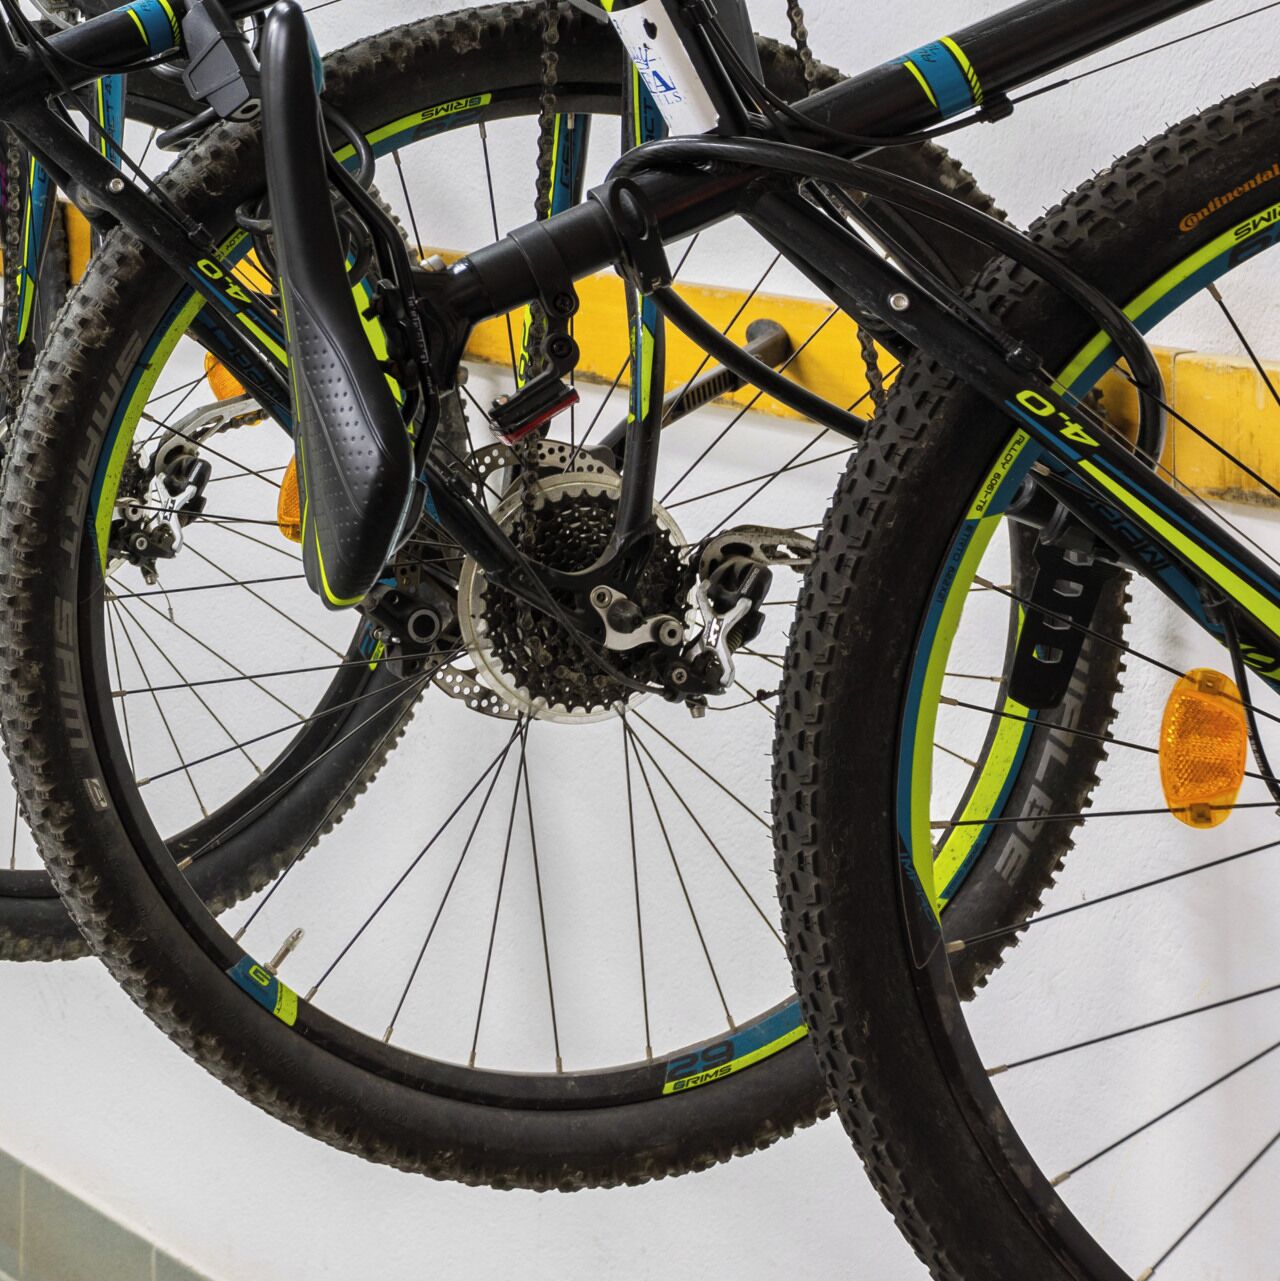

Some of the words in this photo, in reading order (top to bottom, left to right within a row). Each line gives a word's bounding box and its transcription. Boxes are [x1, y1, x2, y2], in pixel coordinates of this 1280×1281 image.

[197, 258, 253, 314] 4.0
[1015, 389, 1101, 448] 4.0
[1000, 434, 1025, 470] ALLOY
[975, 471, 1002, 513] 6061-T6
[53, 596, 90, 750] SAM
[670, 1039, 736, 1082] 29
